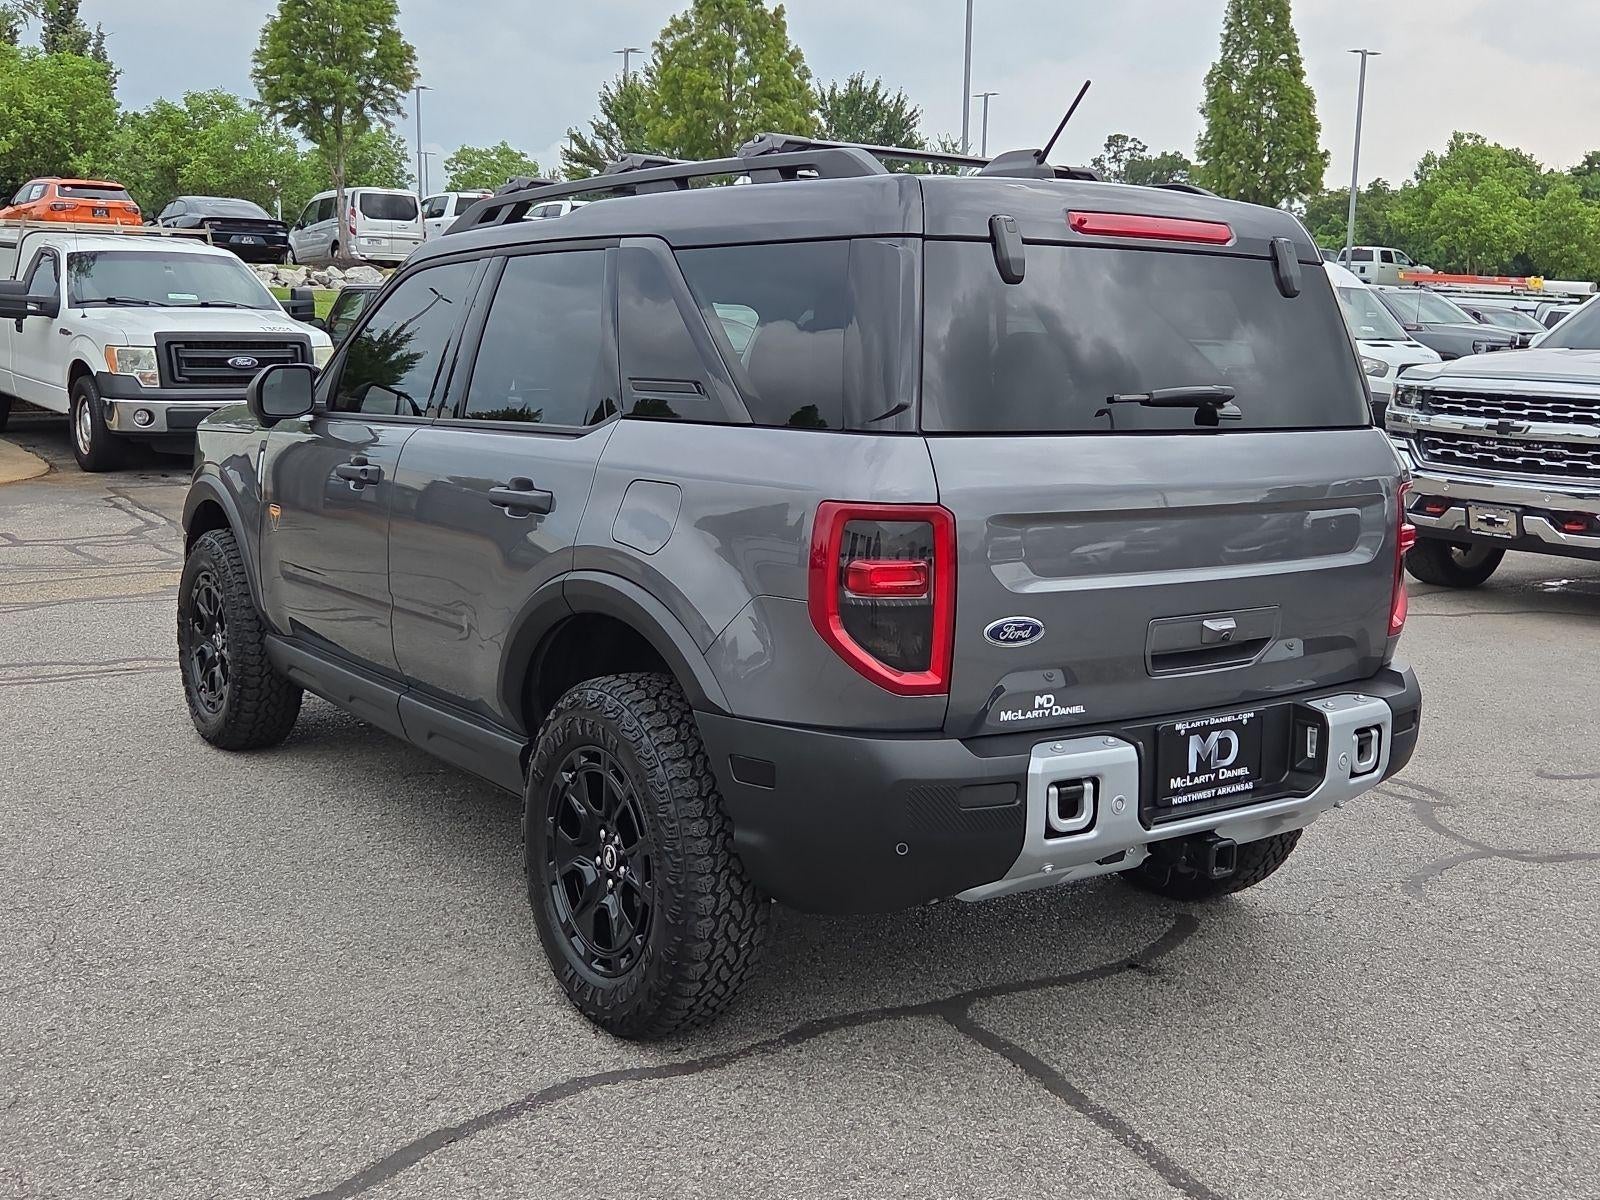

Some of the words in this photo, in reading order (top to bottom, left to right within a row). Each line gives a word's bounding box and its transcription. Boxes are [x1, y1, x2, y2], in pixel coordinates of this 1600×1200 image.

[235, 358, 252, 366] Ford
[999, 623, 1033, 640] Ford
[1034, 694, 1055, 709] MD
[1188, 729, 1239, 774] MD
[1172, 789, 1216, 805] NORTHWEST
[1216, 782, 1254, 796] ARKANSAS
